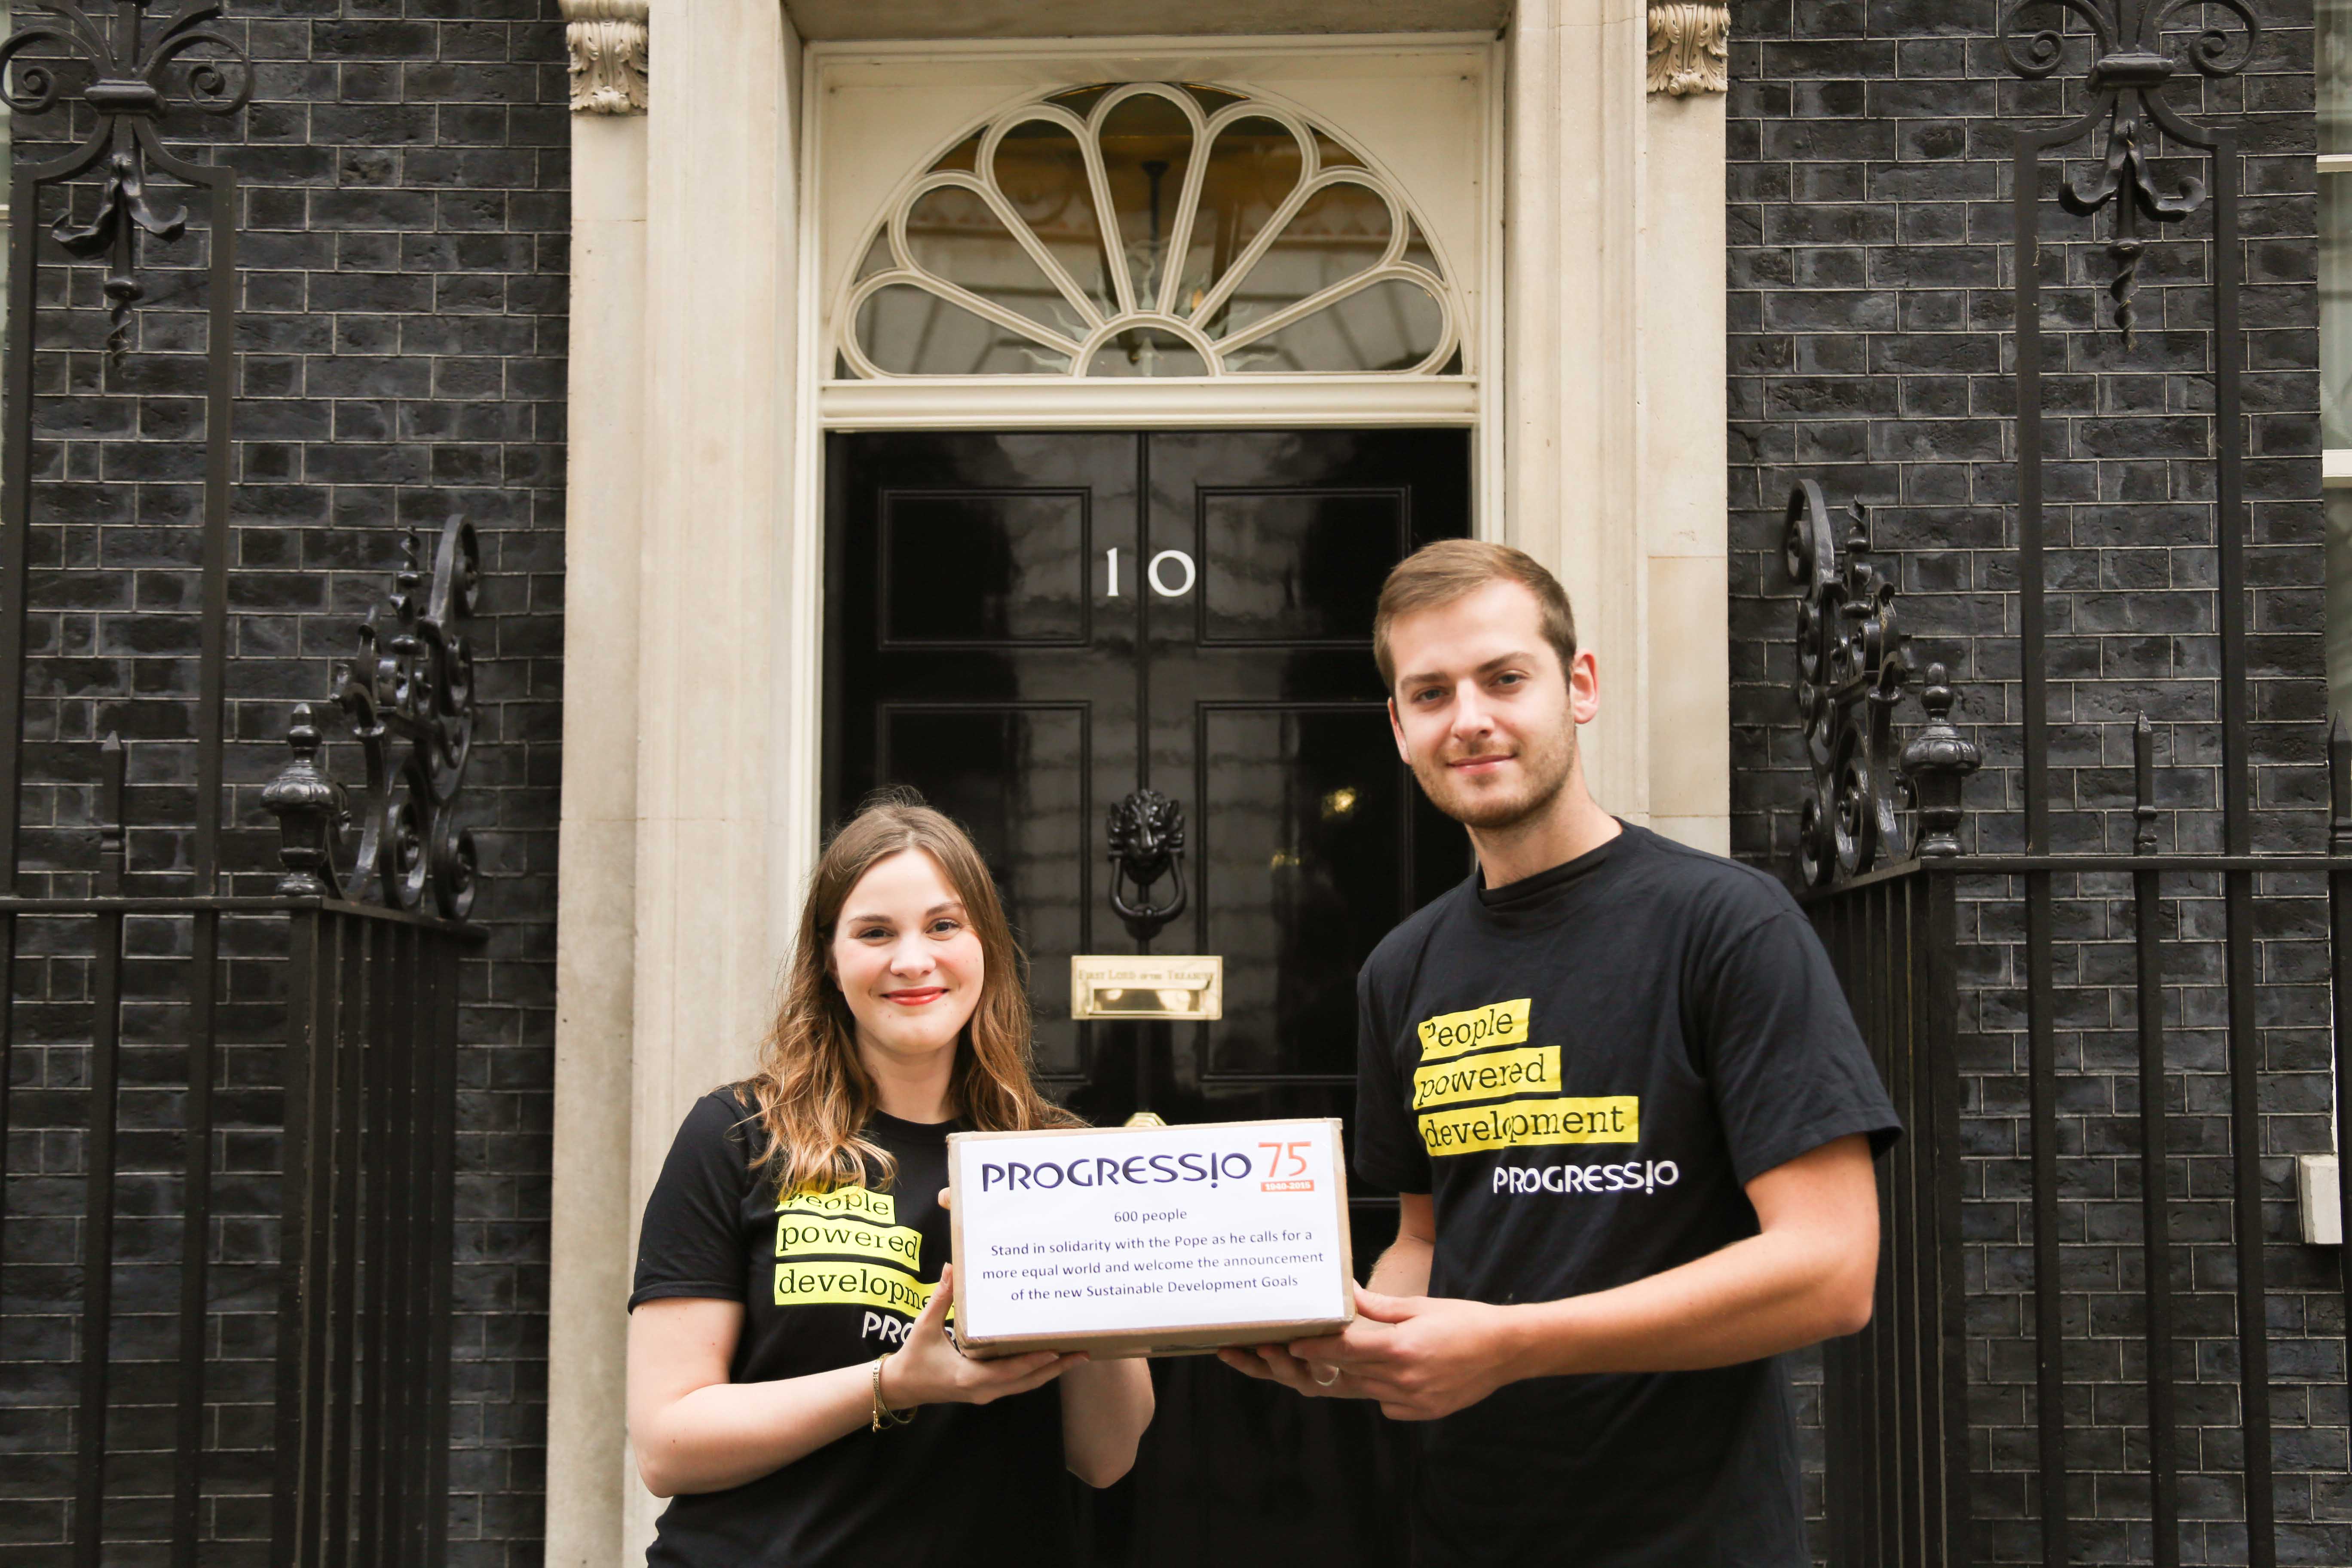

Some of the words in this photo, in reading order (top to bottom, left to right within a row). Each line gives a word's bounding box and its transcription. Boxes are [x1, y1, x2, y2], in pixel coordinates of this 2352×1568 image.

[1107, 548, 1196, 597] 10
[1418, 1053, 1546, 1106] powered
[1425, 1105, 1624, 1147] development
[1258, 1141, 1311, 1178] 75
[1114, 1211, 1138, 1222] 600
[1142, 1208, 1187, 1225] people
[780, 1226, 918, 1261] powered
[991, 1242, 1029, 1256] Stand
[1033, 1242, 1045, 1254] in
[1049, 1240, 1111, 1253] solidarity
[1115, 1237, 1144, 1250] with
[1148, 1236, 1170, 1248] the
[1175, 1235, 1207, 1249] Pope
[1212, 1237, 1226, 1245] as
[1230, 1232, 1246, 1243] he
[1250, 1230, 1278, 1243] calls
[1282, 1230, 1301, 1241] for
[1305, 1231, 1312, 1240] a
[983, 1270, 1017, 1280] more
[1022, 1264, 1058, 1280] equal
[1062, 1262, 1101, 1275] world
[1105, 1260, 1130, 1273] and
[1133, 1259, 1193, 1271] welcome
[1197, 1256, 1219, 1268] the
[1224, 1252, 1323, 1267] announcement
[779, 1269, 931, 1310] developme
[1011, 1289, 1024, 1301] of
[1028, 1288, 1050, 1300] the
[1054, 1289, 1082, 1298] new
[1086, 1281, 1163, 1297] Sustainable
[1168, 1278, 1257, 1293] Development
[1261, 1275, 1298, 1287] Goals
